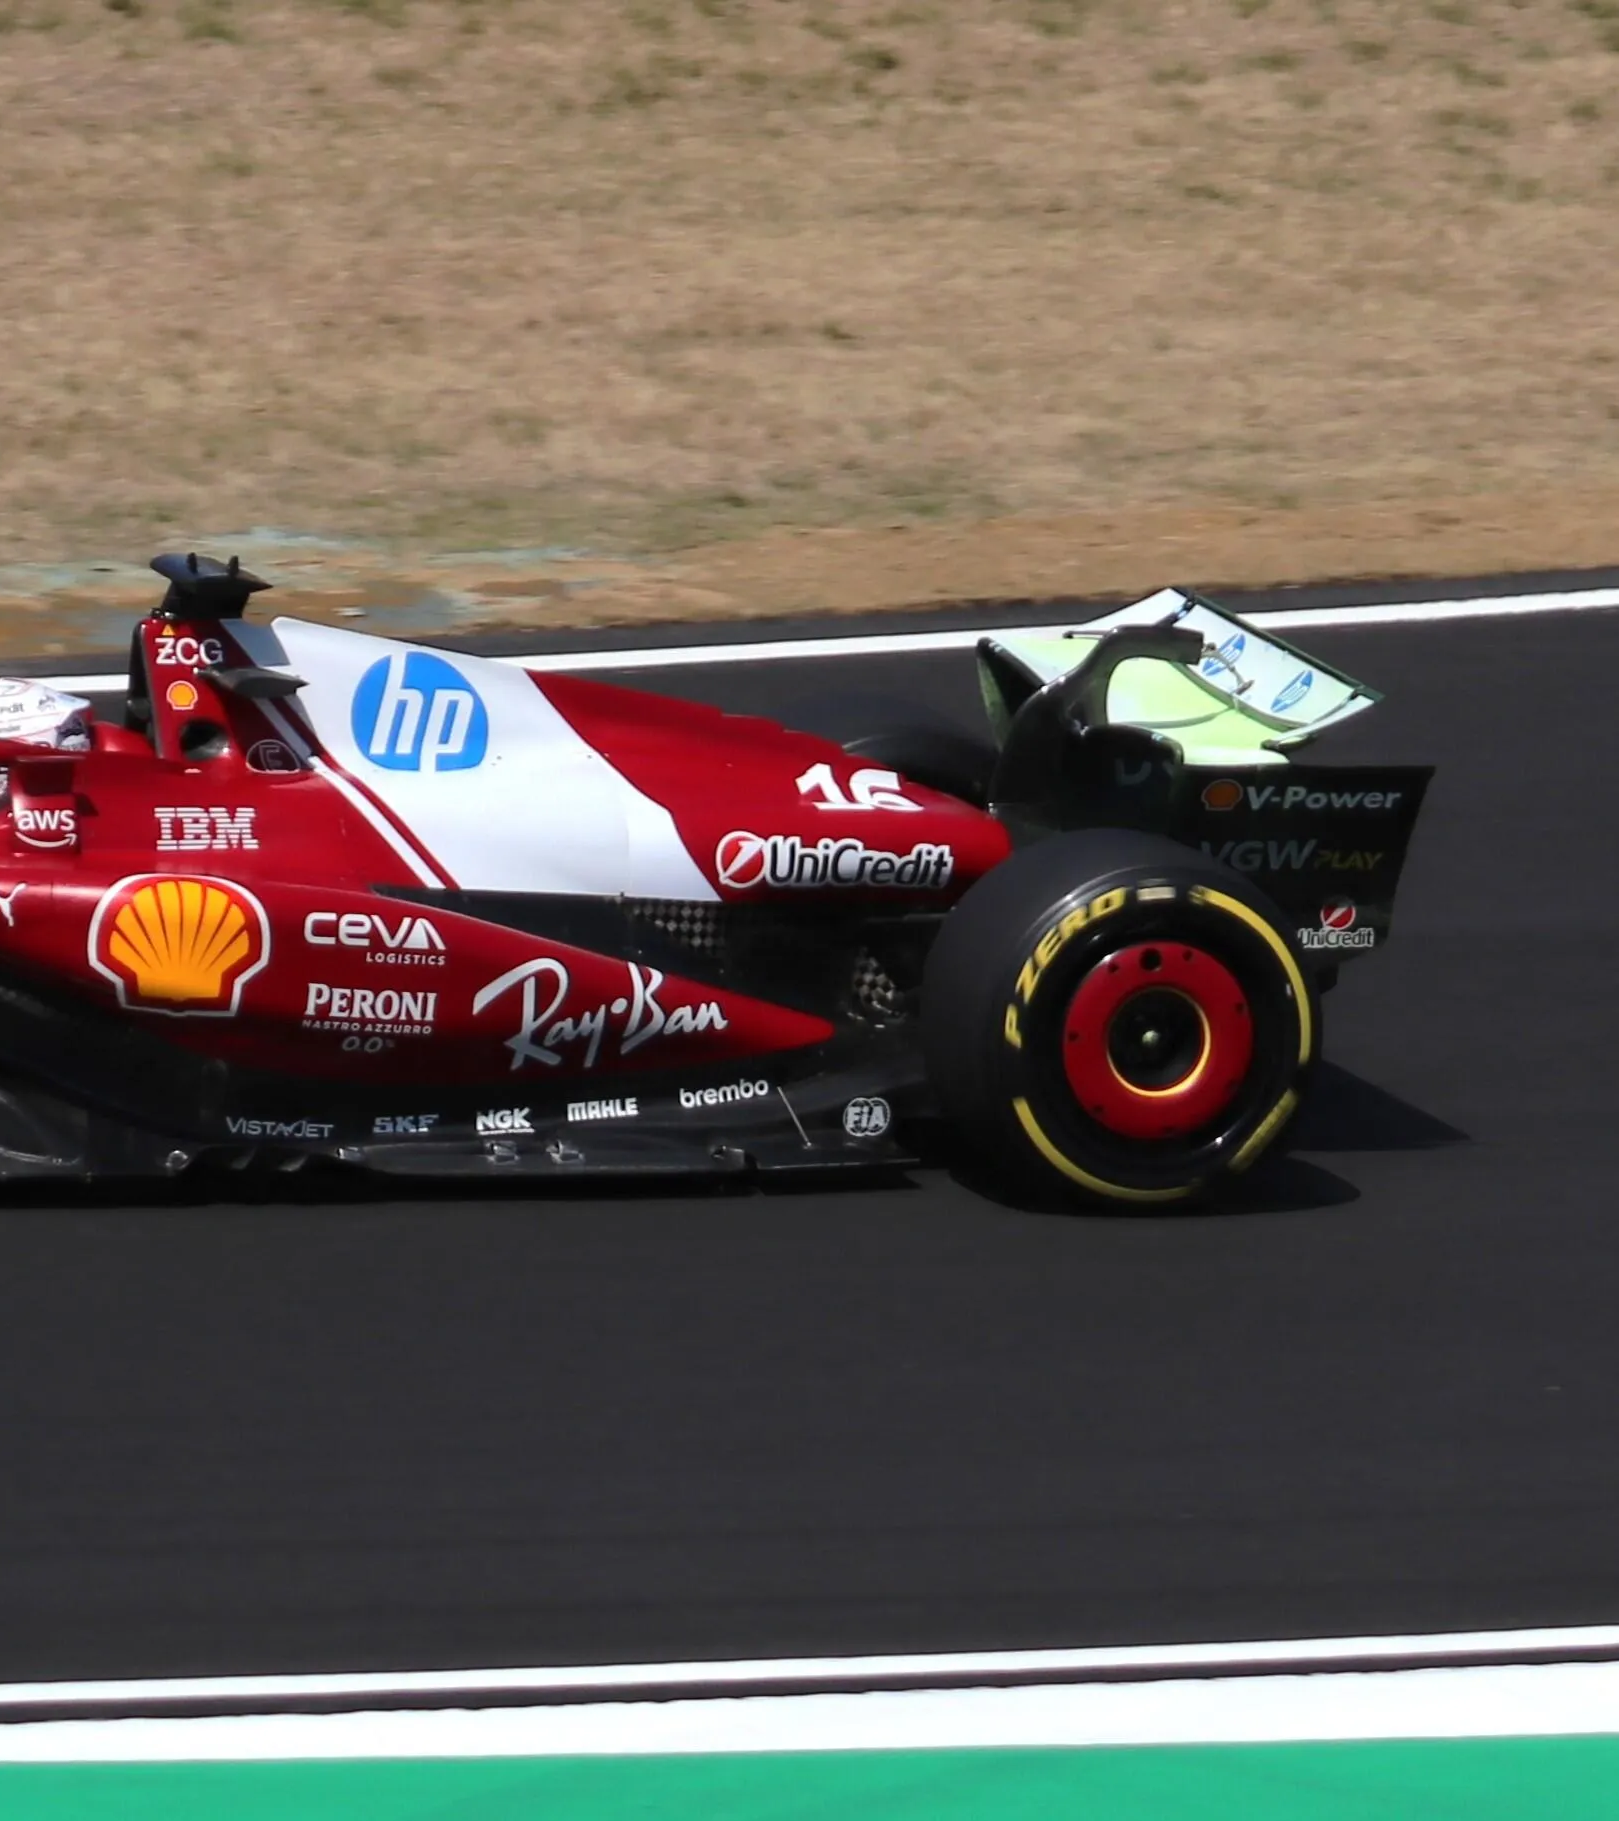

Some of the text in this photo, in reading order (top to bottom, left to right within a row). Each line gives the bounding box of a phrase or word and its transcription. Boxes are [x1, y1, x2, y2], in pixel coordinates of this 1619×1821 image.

[367, 651, 475, 772] hp
[795, 763, 925, 812] 16
[1245, 785, 1401, 811] V-Power
[17, 809, 76, 831] aws
[154, 807, 260, 850] IBM
[766, 835, 954, 888] UniCredit
[1314, 850, 1383, 871] PLAY
[1298, 927, 1373, 949] UniCredit
[366, 951, 446, 966] LOGISTICS
[1004, 886, 1130, 1049] P ZERO
[304, 983, 438, 1021] PERONI
[302, 1019, 433, 1035] NASTRO AZZURRO
[679, 1078, 769, 1108] brembo
[476, 1107, 532, 1131] NGK
[567, 1097, 639, 1122] MAHLE
[373, 1114, 440, 1133] SKF
